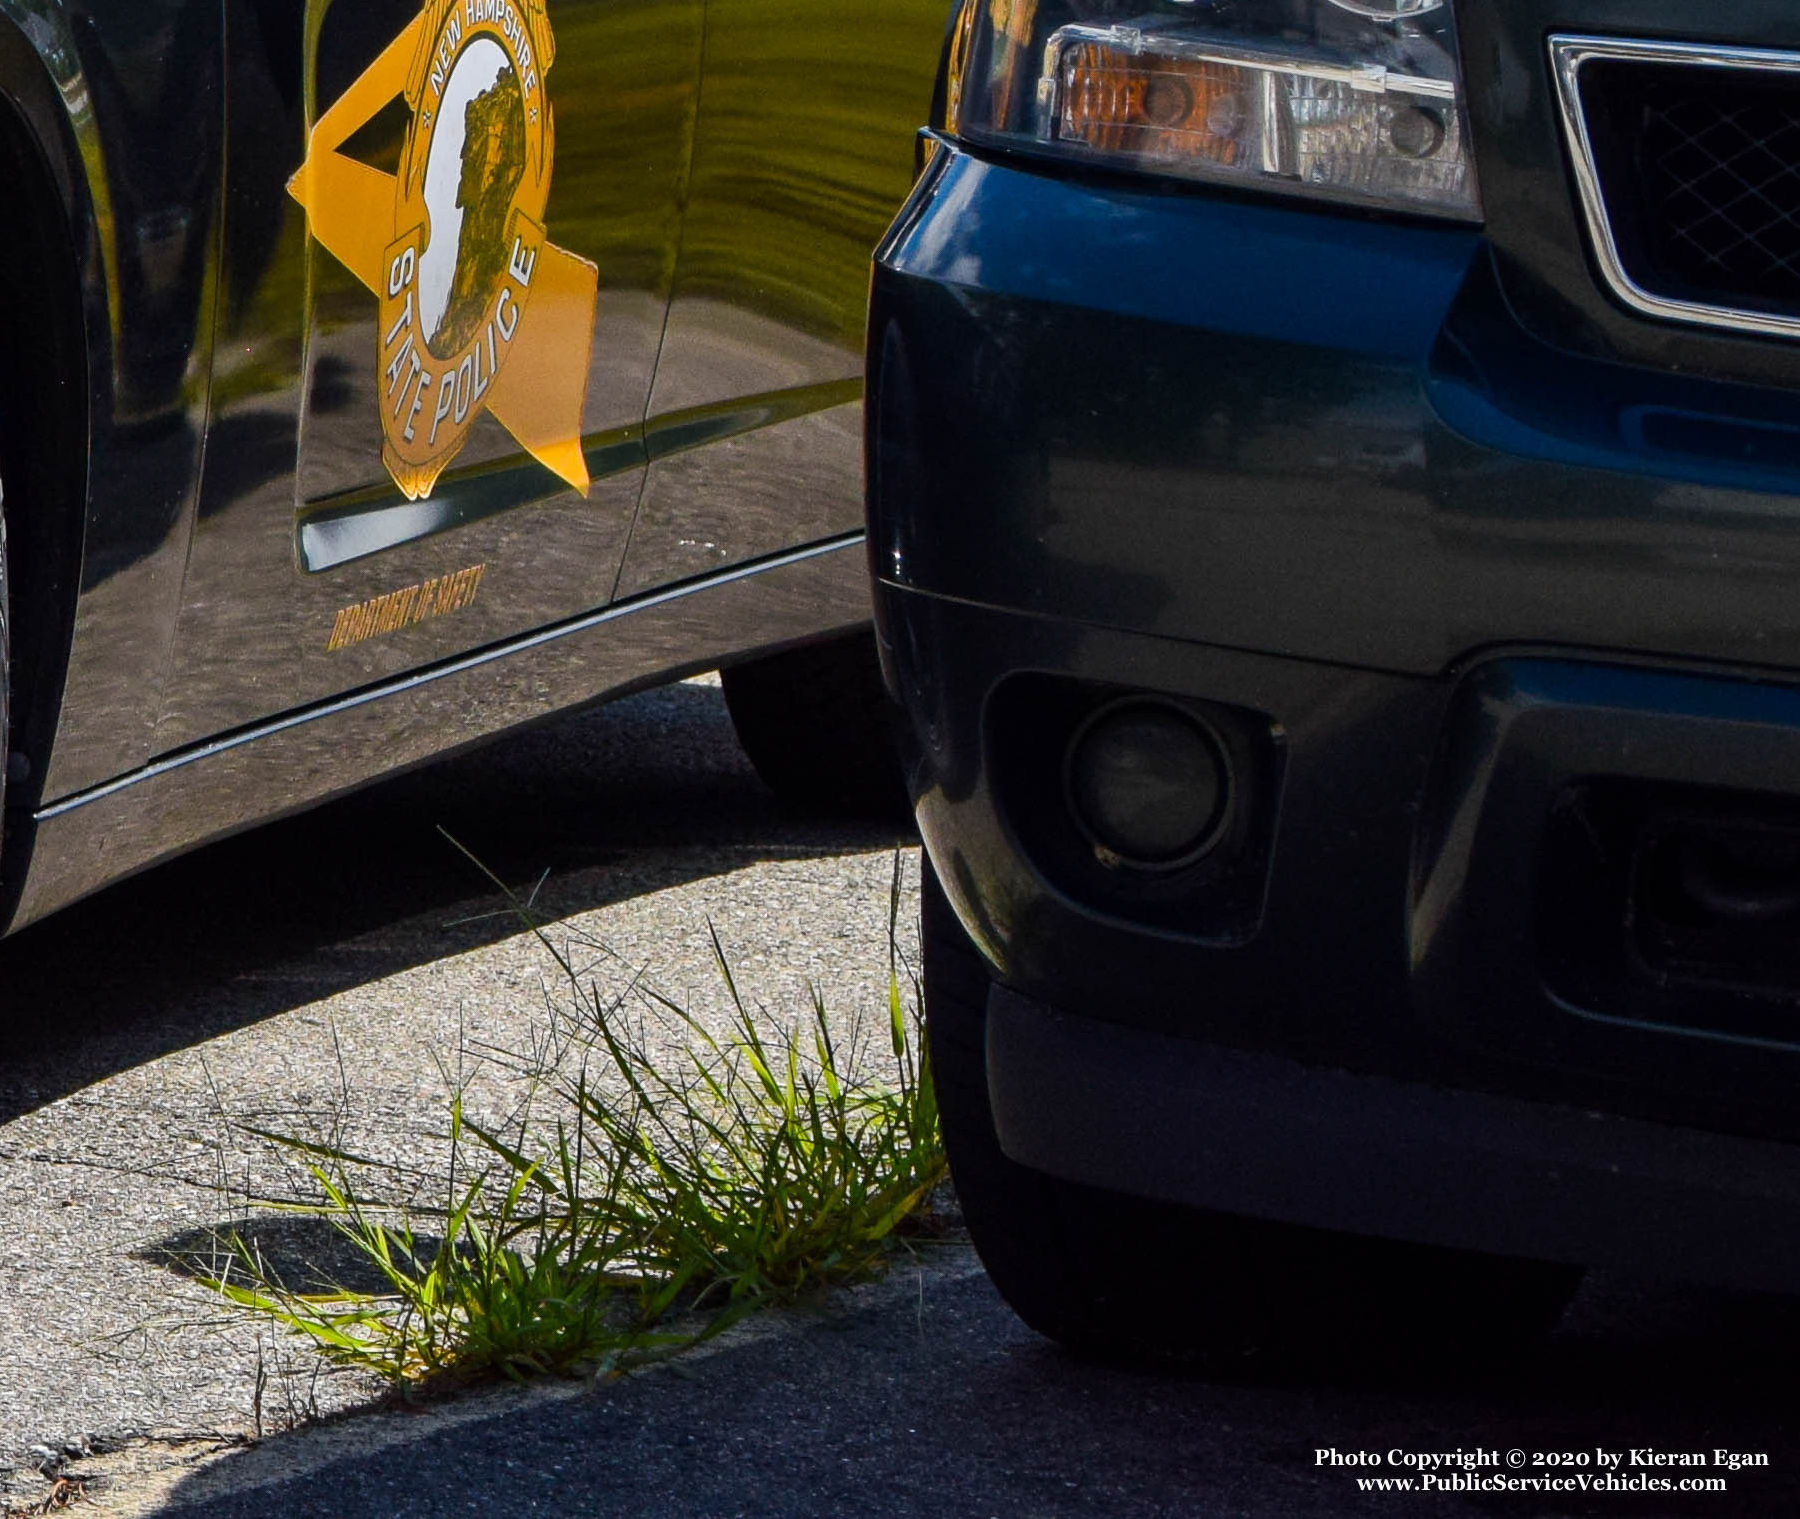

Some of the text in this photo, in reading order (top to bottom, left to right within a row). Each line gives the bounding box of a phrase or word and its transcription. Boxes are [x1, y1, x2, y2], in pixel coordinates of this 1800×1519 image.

[430, 10, 462, 97] NEW
[386, 236, 536, 446] STATE POLICE
